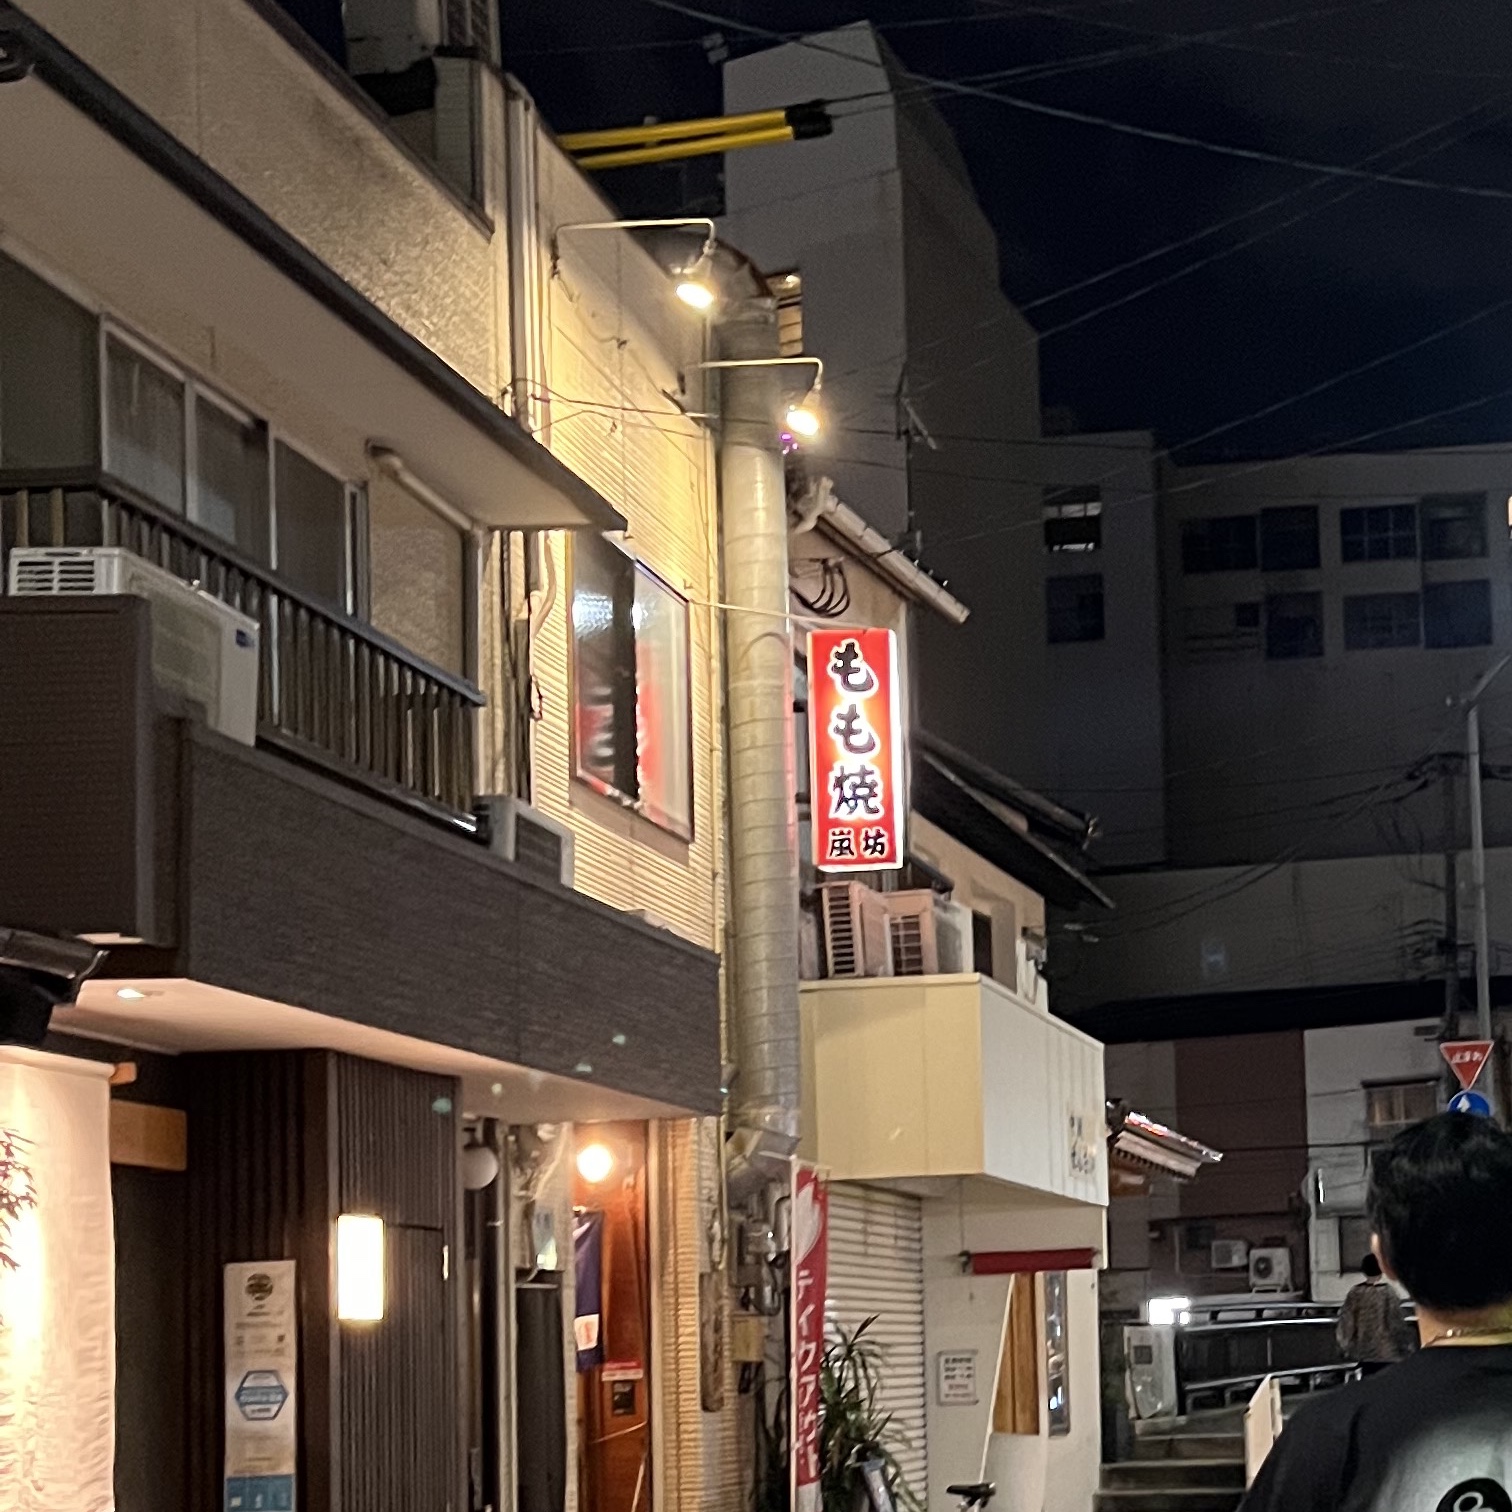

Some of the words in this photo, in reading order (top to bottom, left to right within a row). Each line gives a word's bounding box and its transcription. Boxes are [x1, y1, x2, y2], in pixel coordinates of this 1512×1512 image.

[830, 641, 881, 817] もも焼
[828, 829, 886, 859] 嵐坊
